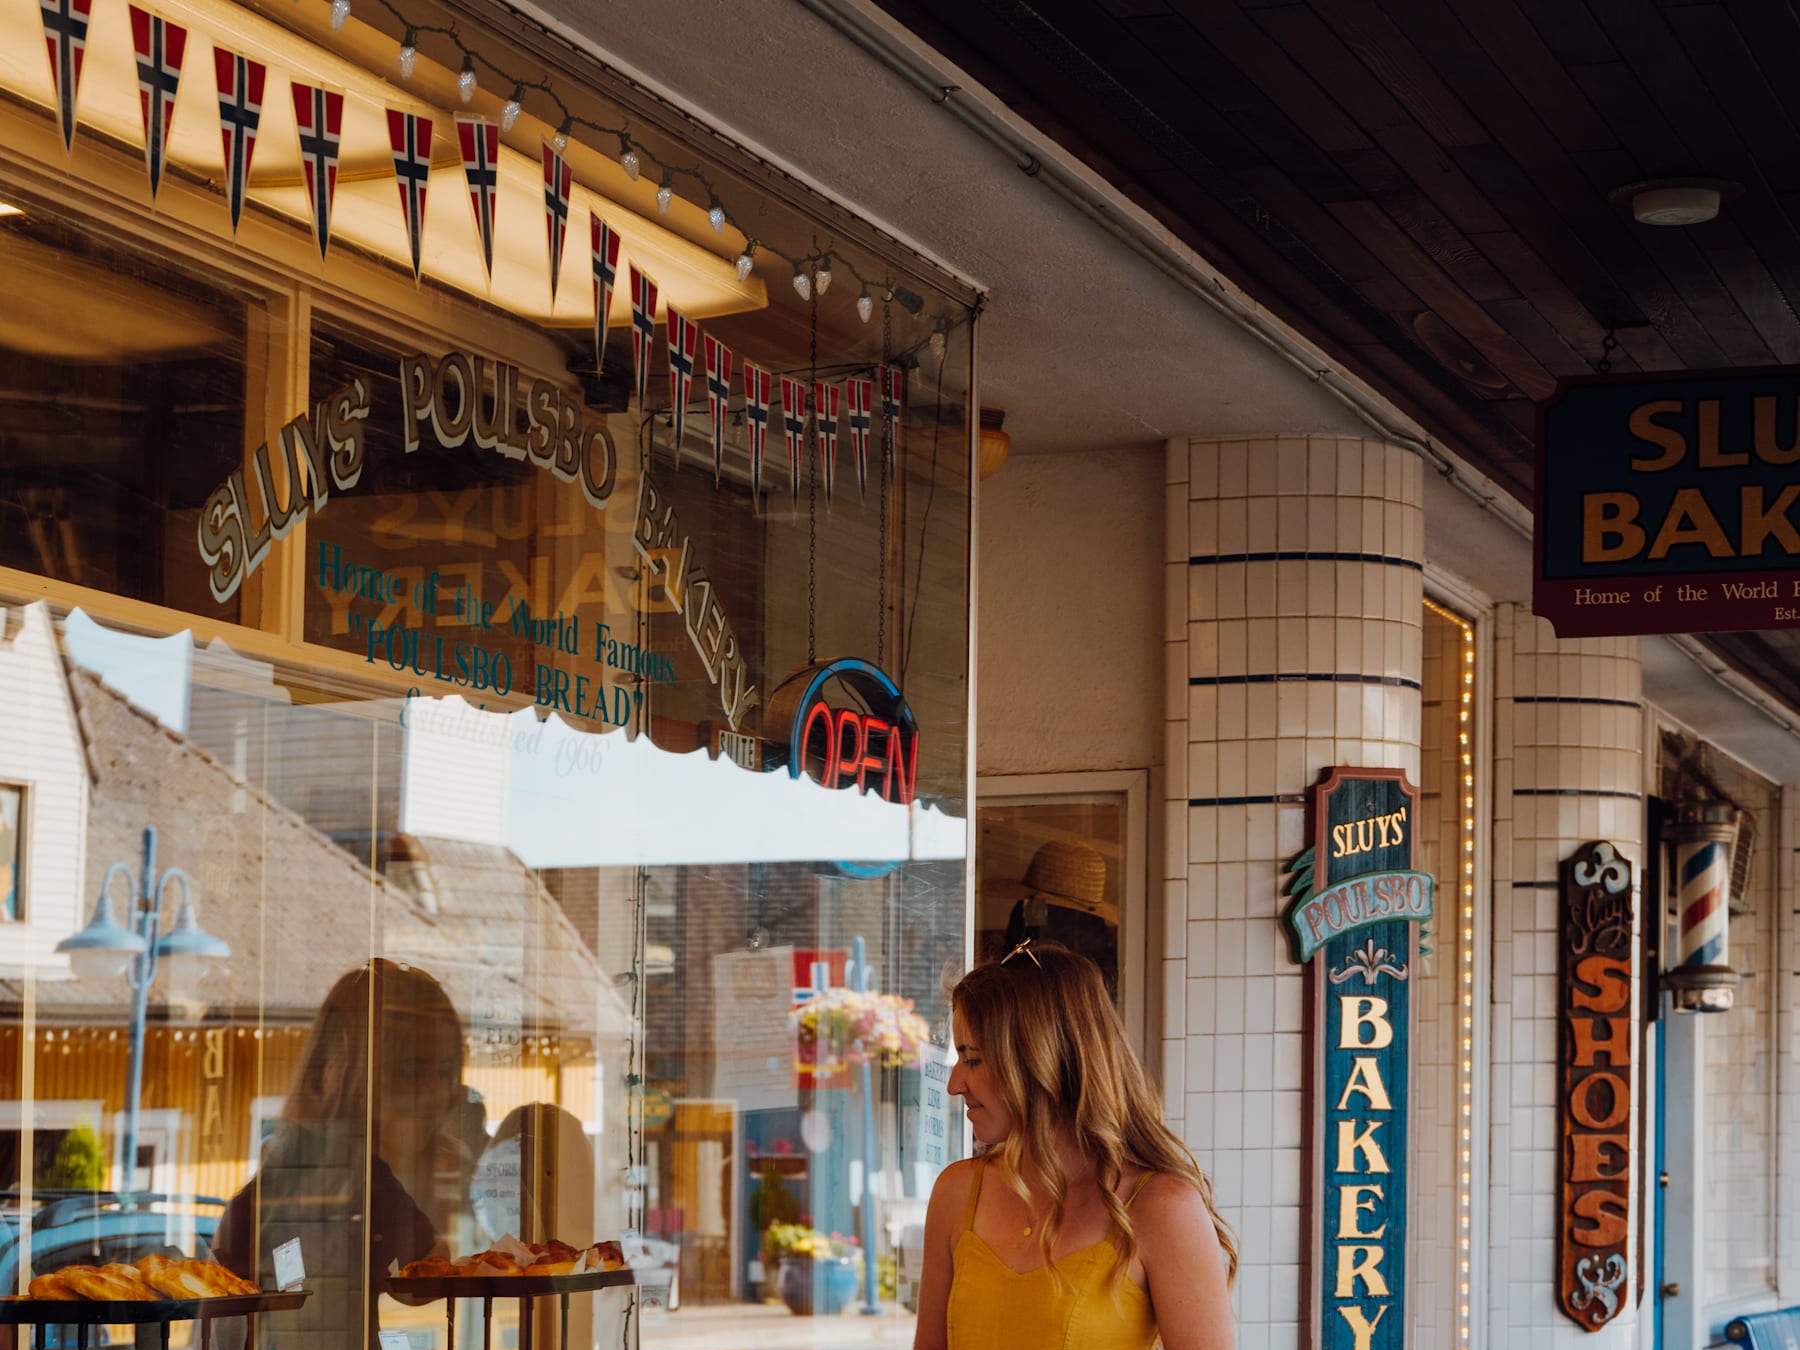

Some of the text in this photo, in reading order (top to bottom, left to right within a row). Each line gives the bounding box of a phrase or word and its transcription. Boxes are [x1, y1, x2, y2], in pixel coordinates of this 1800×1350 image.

[198, 352, 760, 732] SLUYS' POULSBO BAKERY
[1583, 484, 1800, 564] BAK
[317, 541, 401, 605] Home
[413, 571, 442, 616] of
[455, 582, 494, 631] the
[508, 594, 580, 656] World
[595, 622, 676, 686] Famous
[1574, 588, 1631, 605] Home
[1643, 585, 1663, 603] of
[1677, 585, 1709, 601] the
[1721, 581, 1779, 600] World
[347, 612, 513, 697] "POULSBO
[534, 663, 645, 728] BREAD"
[801, 701, 920, 806] OPEN
[1332, 807, 1407, 858] SLUYS'
[1303, 876, 1427, 942] POULSBO
[1570, 956, 1631, 1249] SHOES
